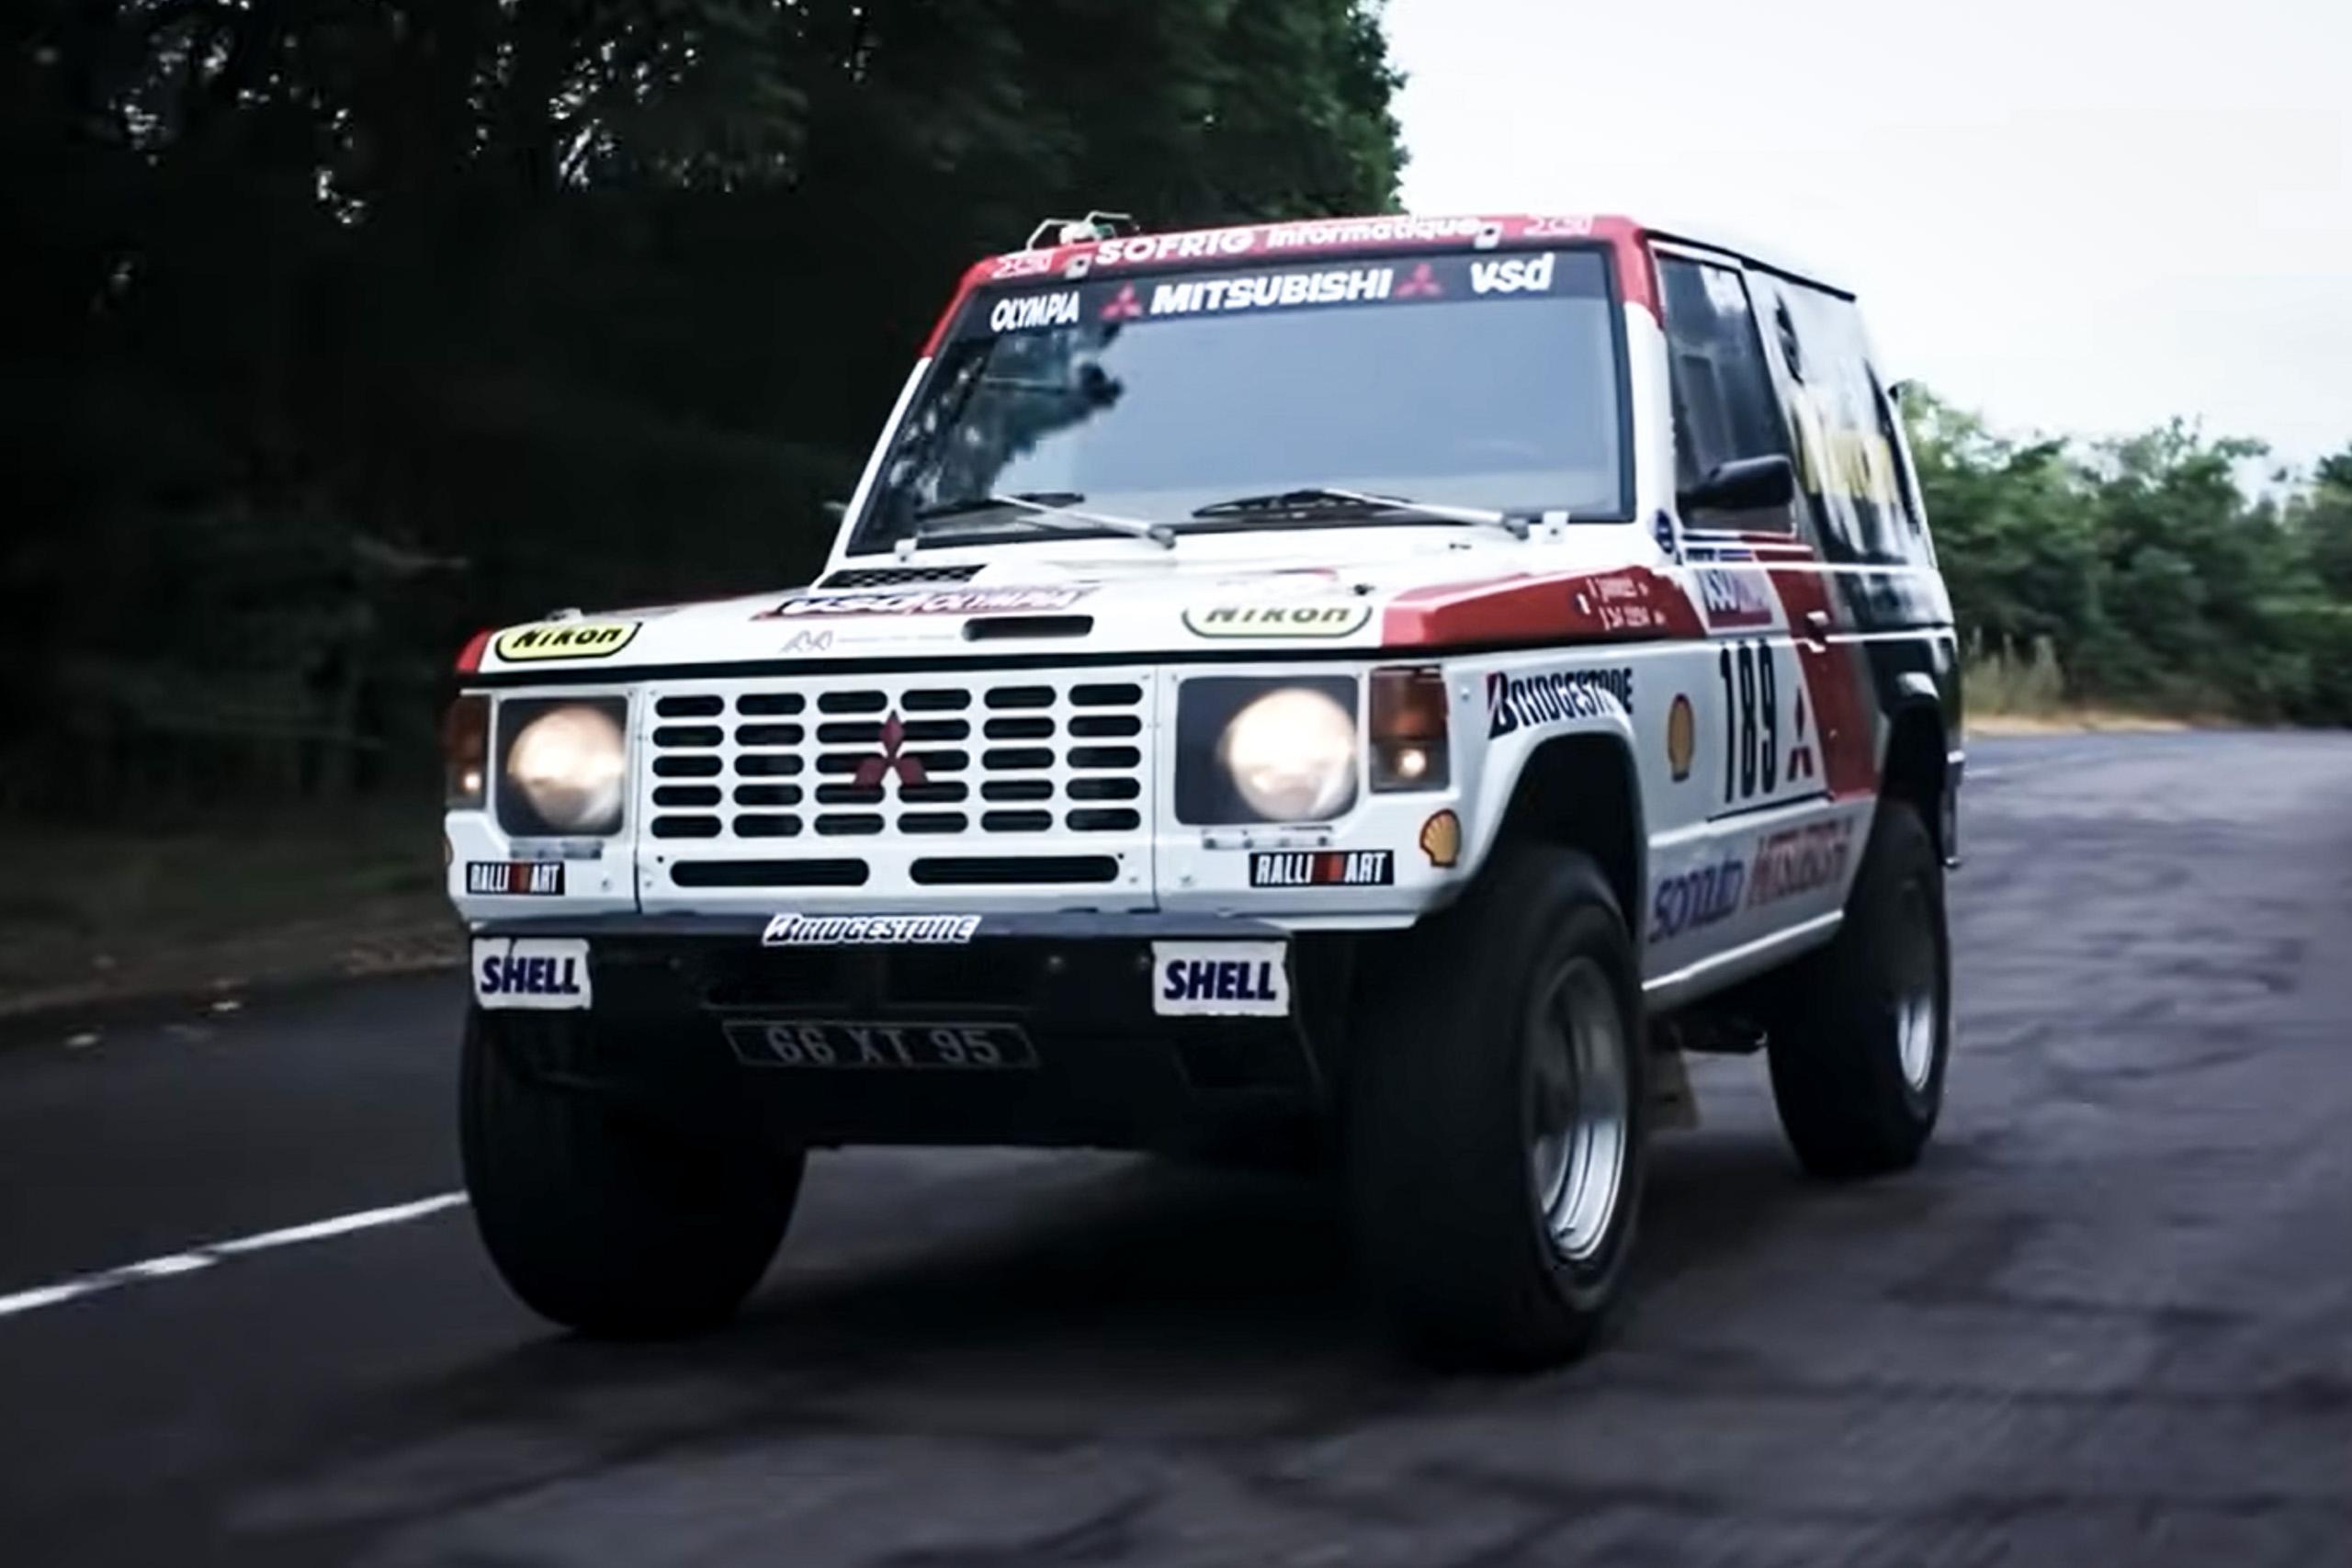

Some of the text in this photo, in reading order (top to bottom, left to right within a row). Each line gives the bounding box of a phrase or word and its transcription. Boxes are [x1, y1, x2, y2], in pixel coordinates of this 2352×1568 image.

[1094, 229, 1254, 265] SOFRIG
[1149, 268, 1394, 315] MITSUBISHI
[1470, 252, 1555, 294] vsd
[989, 291, 1080, 332] OLYMPIA
[1719, 637, 1778, 805] 189
[1254, 852, 1387, 886] RALLI ART
[480, 955, 581, 995] SHELL
[1162, 959, 1277, 1001] SHELL
[765, 1025, 1001, 1066] 66 XT 95
